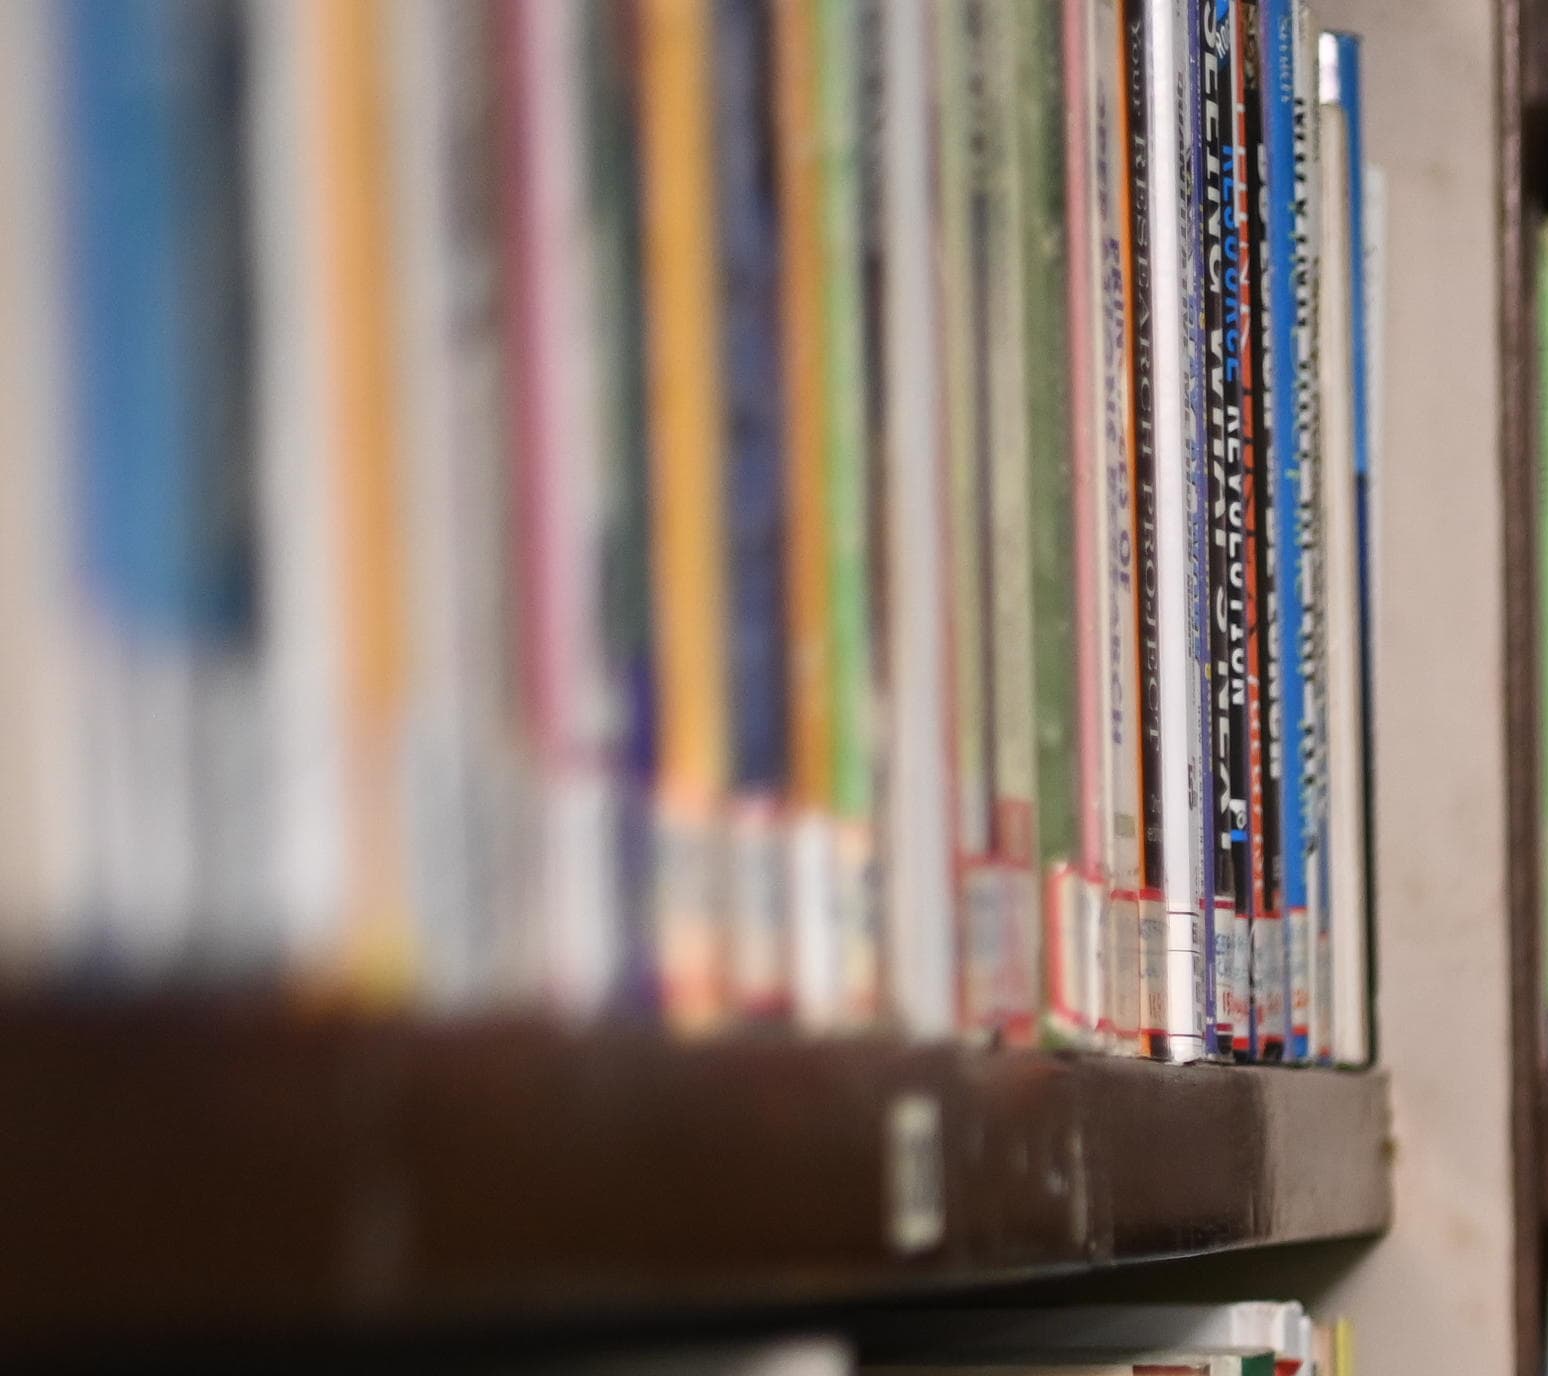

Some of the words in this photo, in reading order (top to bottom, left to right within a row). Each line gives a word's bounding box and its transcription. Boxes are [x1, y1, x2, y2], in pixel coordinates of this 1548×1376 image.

[1131, 19, 1142, 116] Your
[1204, 1, 1223, 293] SEEING
[1134, 134, 1153, 456] RESEARCH
[1222, 144, 1241, 383] RESOURCE
[1142, 481, 1159, 752] PROJECT
[1209, 326, 1230, 636] WHATS
[1227, 405, 1246, 707] REVOLUTION
[1217, 660, 1232, 852] NEXT
